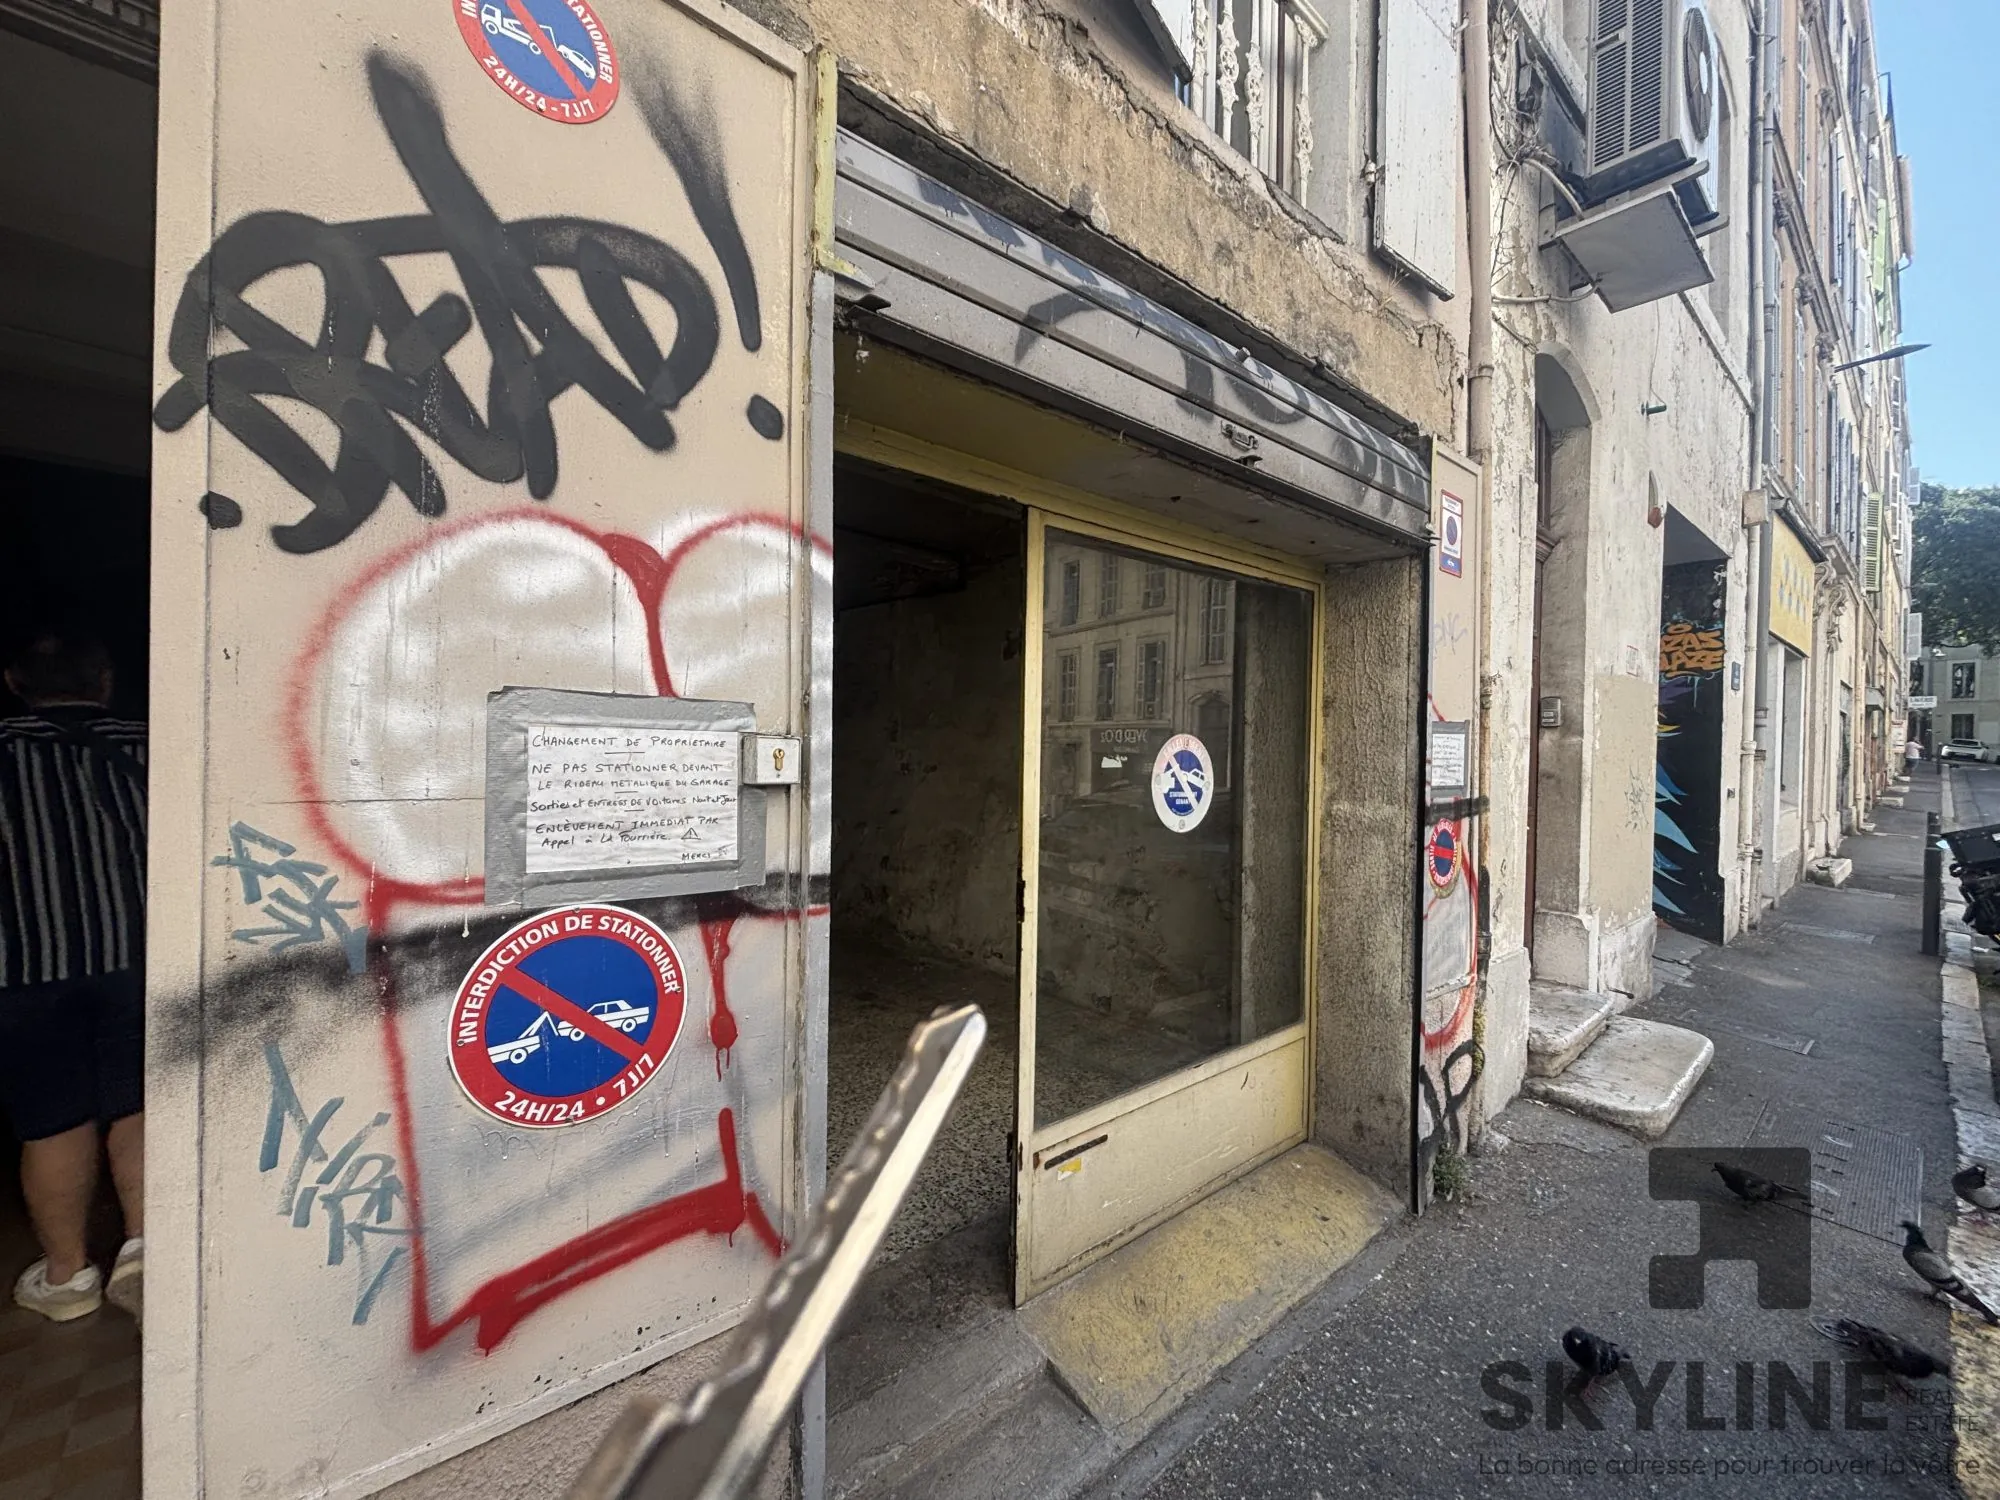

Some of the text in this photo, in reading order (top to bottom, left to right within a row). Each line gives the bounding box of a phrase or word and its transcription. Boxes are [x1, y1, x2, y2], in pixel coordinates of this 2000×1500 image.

[567, 0, 613, 84] TATIONNER
[560, 99, 595, 118] 7J/7
[532, 732, 727, 748] CHANGEMENT DE PROPRIETAIRE
[532, 763, 723, 774] NE PAS STATIONNER DEVANT
[538, 780, 552, 790] LE
[530, 800, 570, 812] Sorties
[572, 798, 583, 808] et
[630, 798, 642, 806] DE
[535, 816, 720, 834] ENLÈVEMENT IMMEDIAT PAR
[541, 836, 575, 849] Appel
[681, 852, 711, 860] MERCI
[458, 915, 679, 1043] INTERDICTION DE STATIONNER
[494, 1091, 585, 1122] 24H/24
[612, 1053, 655, 1097] 7J/7
